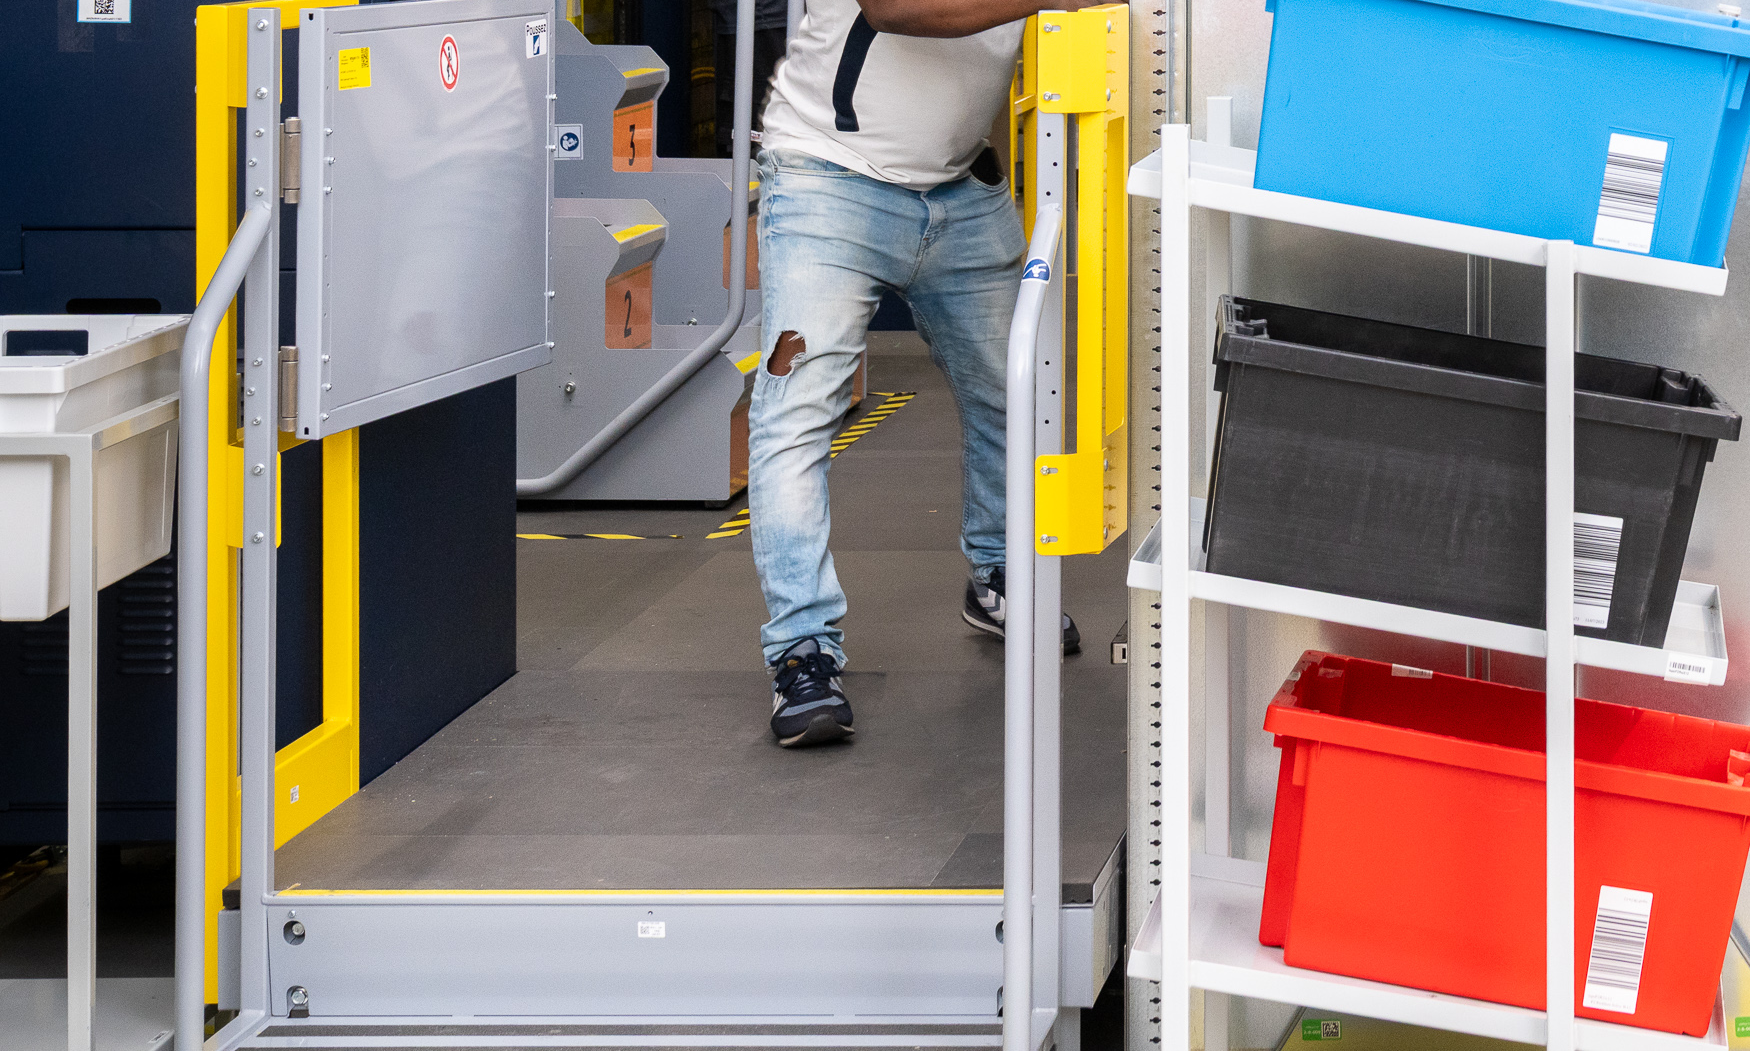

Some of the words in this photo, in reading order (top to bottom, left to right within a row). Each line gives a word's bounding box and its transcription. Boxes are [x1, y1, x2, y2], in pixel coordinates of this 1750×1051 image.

[526, 23, 547, 36] Poussez
[628, 123, 636, 167] 3
[624, 289, 632, 338] 2
